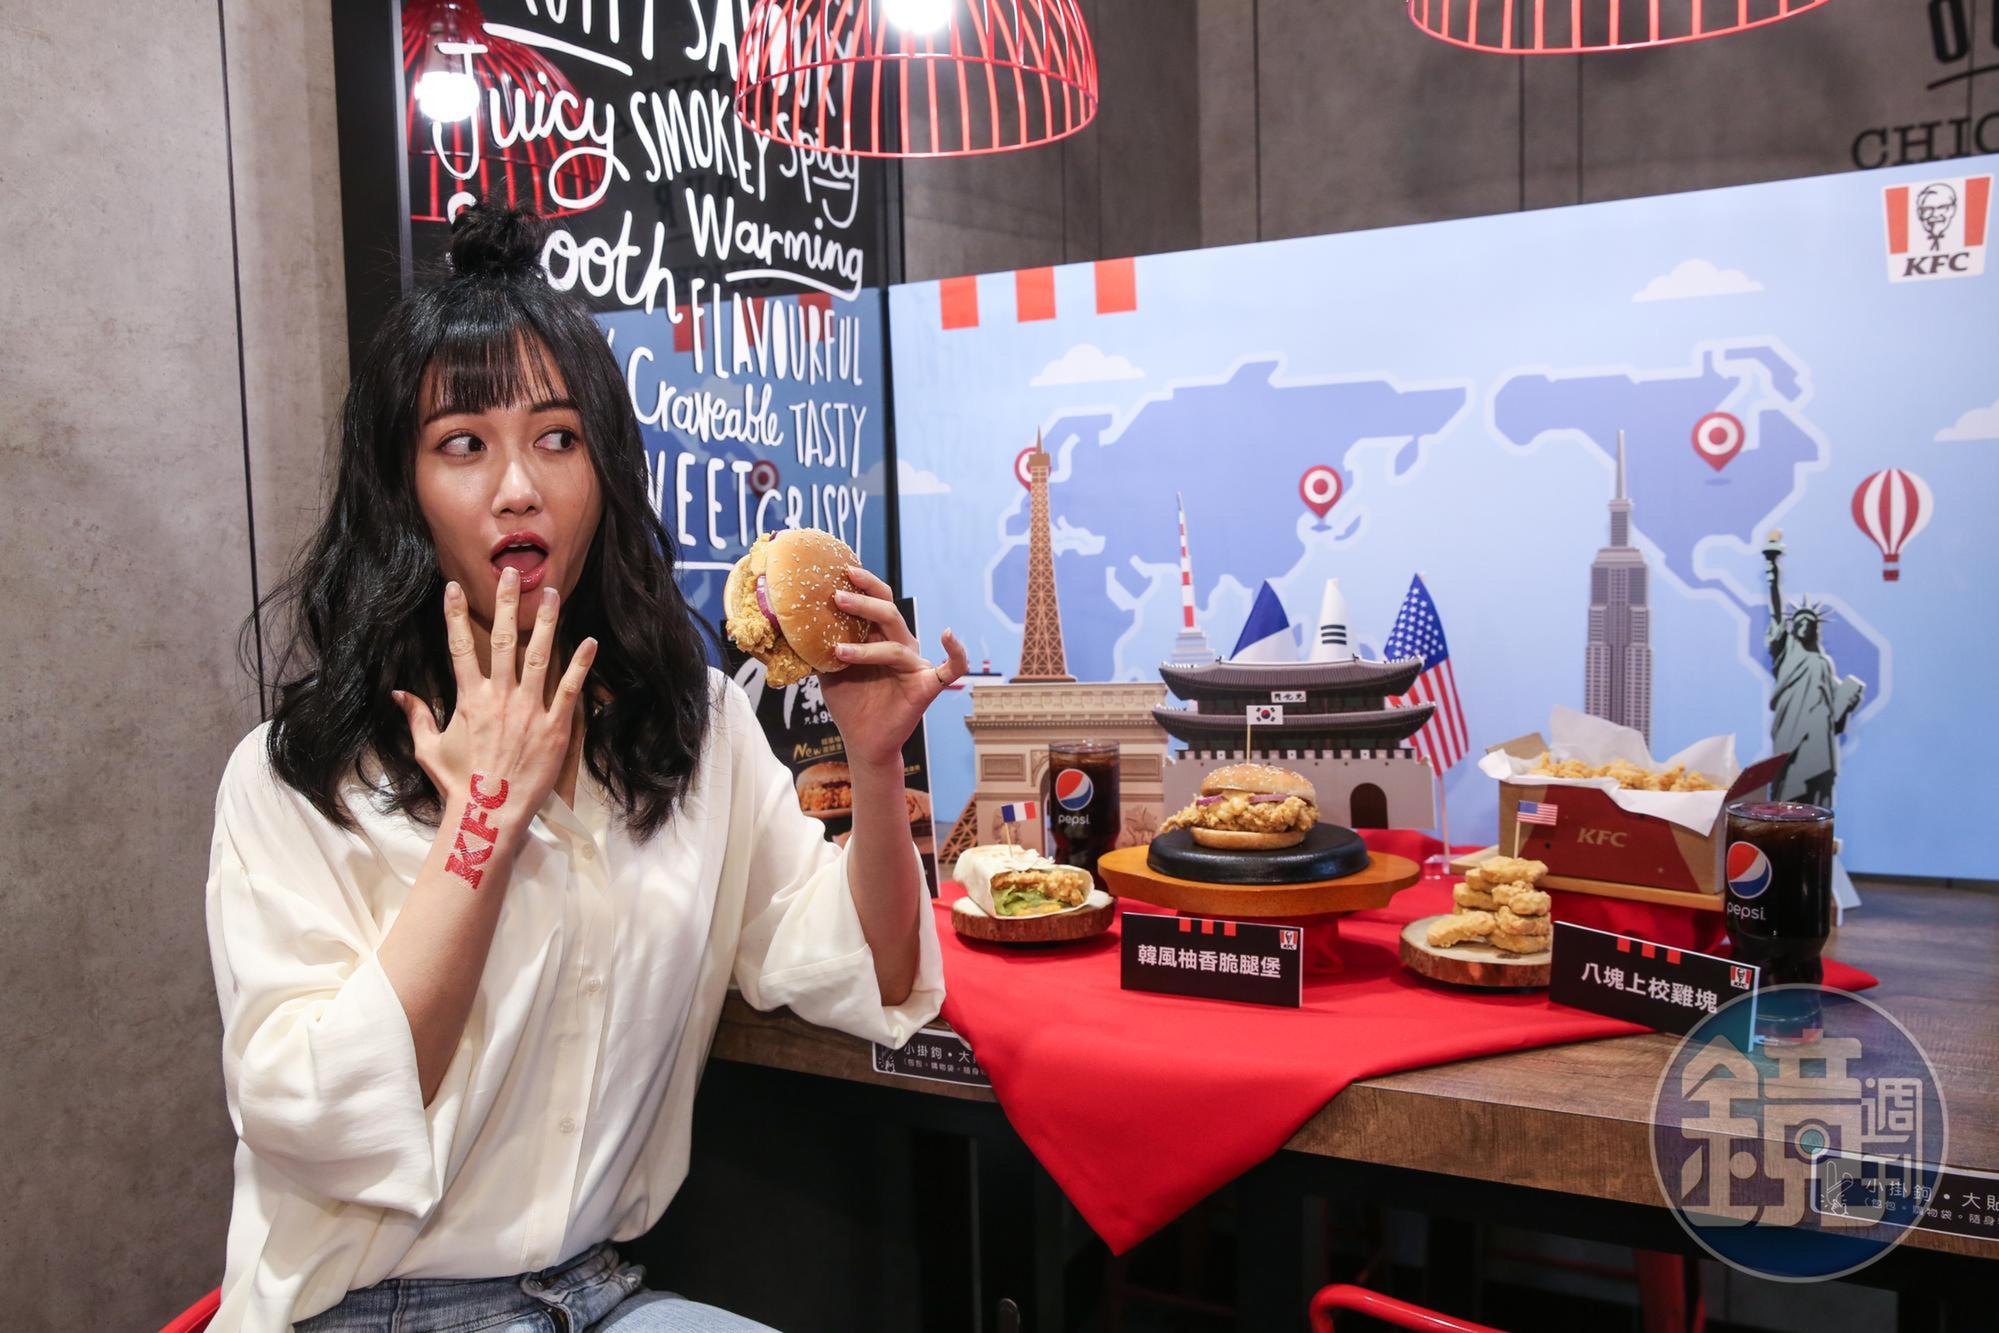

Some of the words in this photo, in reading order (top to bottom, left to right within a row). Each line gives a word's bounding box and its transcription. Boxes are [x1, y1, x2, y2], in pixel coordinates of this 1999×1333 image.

[432, 42, 630, 209] Juicy
[630, 89, 769, 202] SMOKEY
[685, 188, 863, 300] Warming
[1902, 252, 1970, 277] KFC
[691, 278, 862, 386] FLAVOURFUL
[627, 347, 784, 447] Craveable
[788, 399, 867, 478] TASTY
[756, 484, 866, 562] CRISPY
[444, 773, 509, 890] KFC
[1058, 814, 1090, 826] pepsi
[1576, 827, 1629, 848] KFC
[1727, 902, 1766, 920] pepsi
[1138, 943, 1281, 979] 韓風柚香脆腿堡
[1581, 962, 1718, 1014] 八塊上校雞塊
